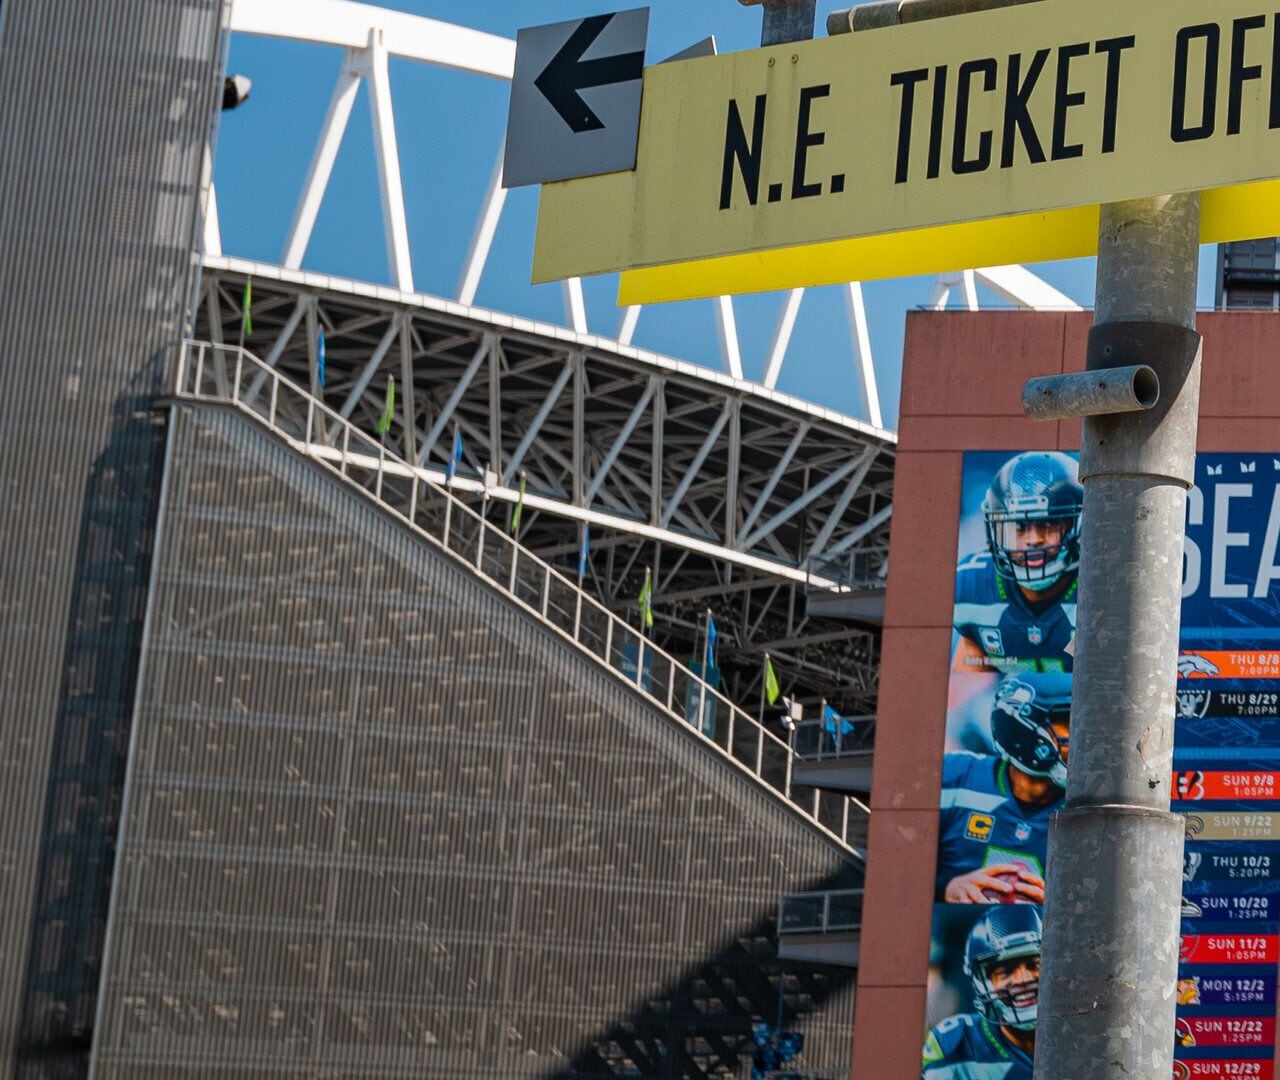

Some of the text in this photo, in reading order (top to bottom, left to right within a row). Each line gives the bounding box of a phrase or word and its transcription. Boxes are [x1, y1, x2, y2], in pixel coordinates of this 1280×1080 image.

[718, 83, 846, 210] N.E.
[890, 34, 1136, 185] TICKET
[1229, 654, 1280, 665] THU 8/8
[1220, 694, 1278, 705] THU 8/29
[1223, 775, 1274, 786] SUN 9/8
[1213, 816, 1272, 826] SUN 9/22
[1212, 856, 1270, 867] THU 10/3
[1201, 897, 1268, 909] SUN 10/20
[1207, 938, 1267, 949] SUN 11/3
[1203, 980, 1265, 991] MON 12/2
[1194, 1021, 1263, 1032] SUN 12/22
[1192, 1063, 1260, 1074] SUN 12/29
